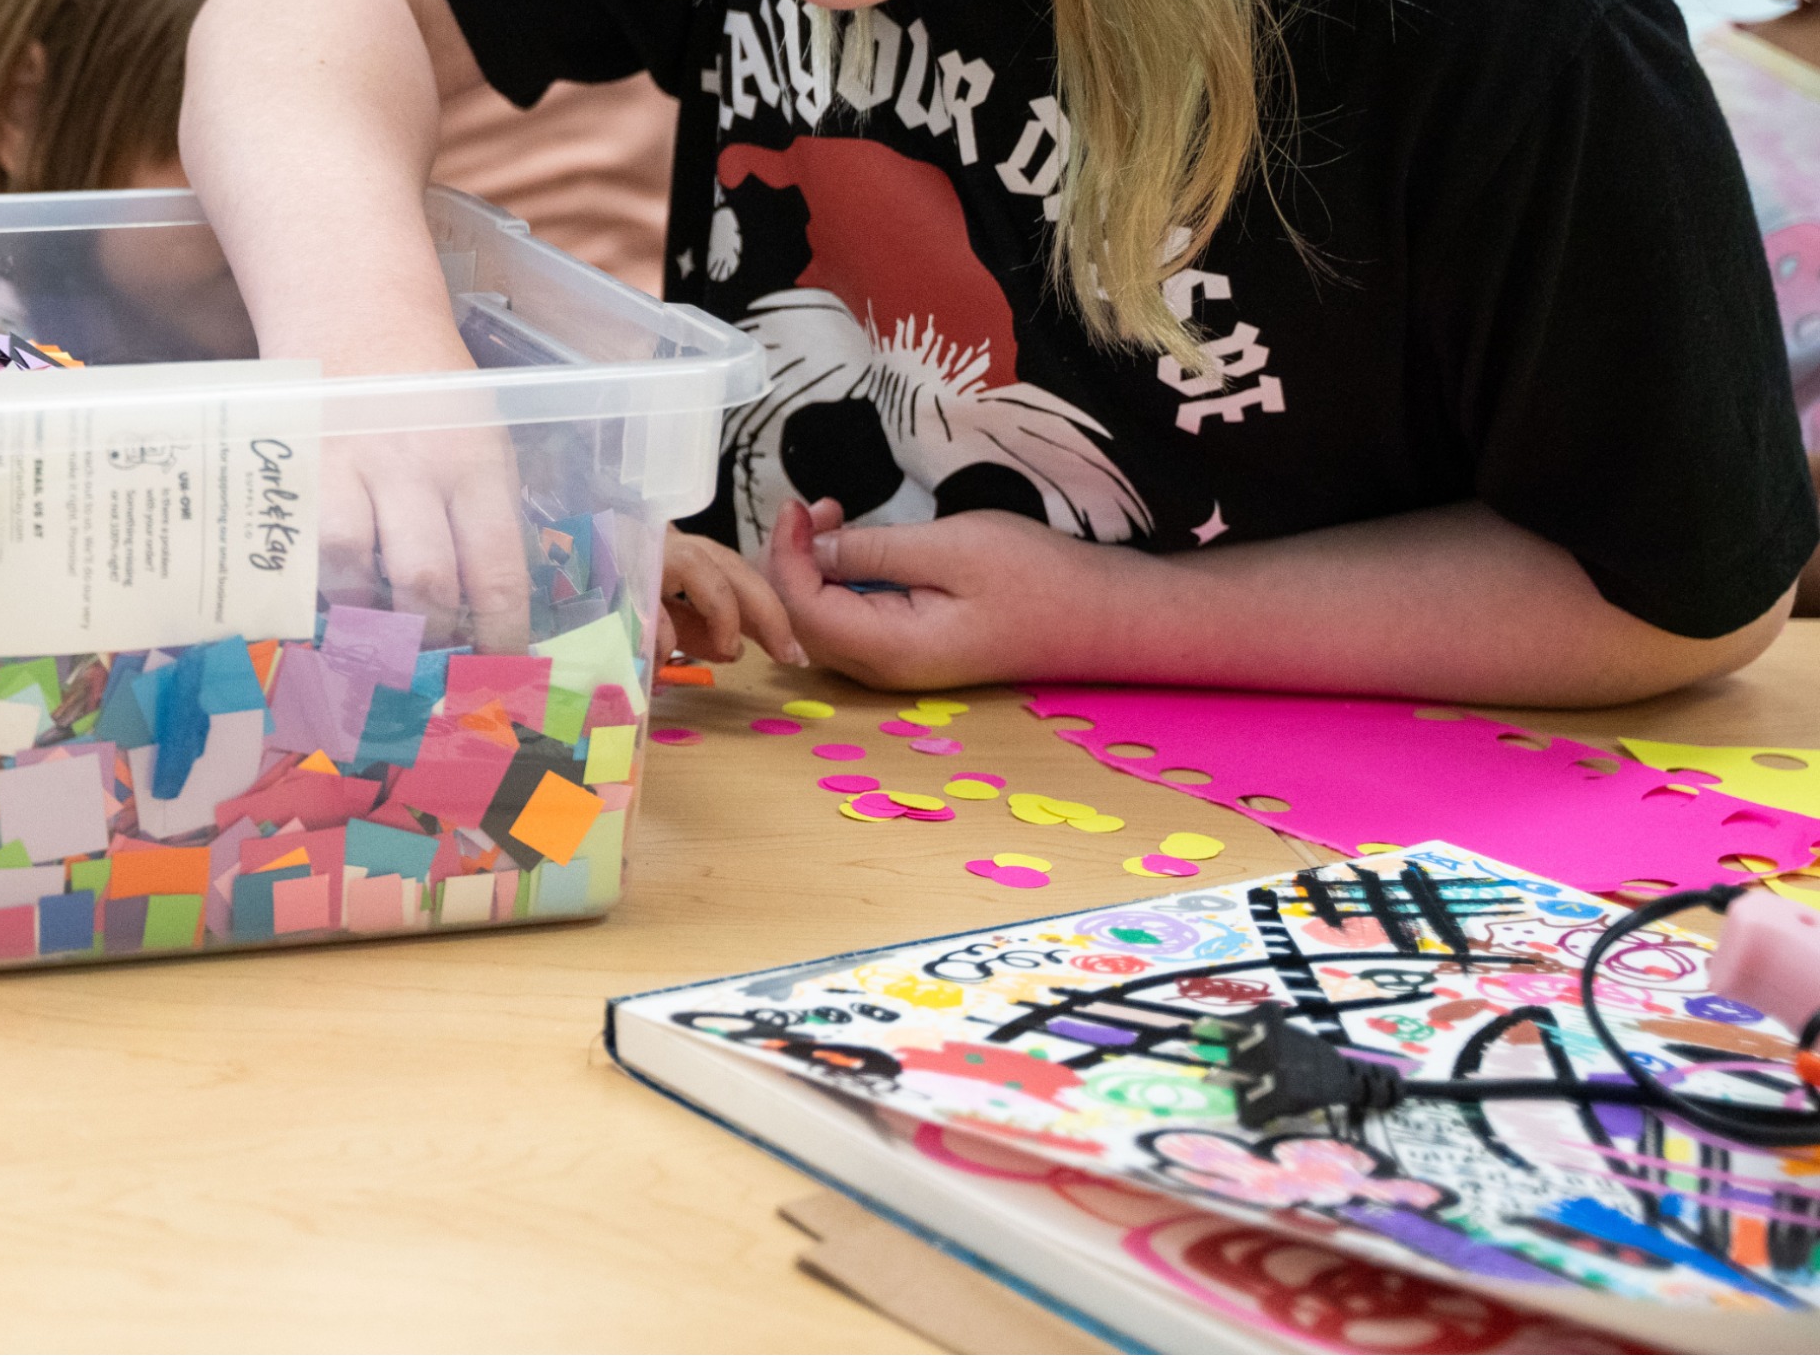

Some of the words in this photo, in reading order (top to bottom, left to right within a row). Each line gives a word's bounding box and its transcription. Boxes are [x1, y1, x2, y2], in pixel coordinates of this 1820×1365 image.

[124, 489, 136, 546] Something
[218, 466, 228, 524] supporting
[218, 547, 228, 573] small
